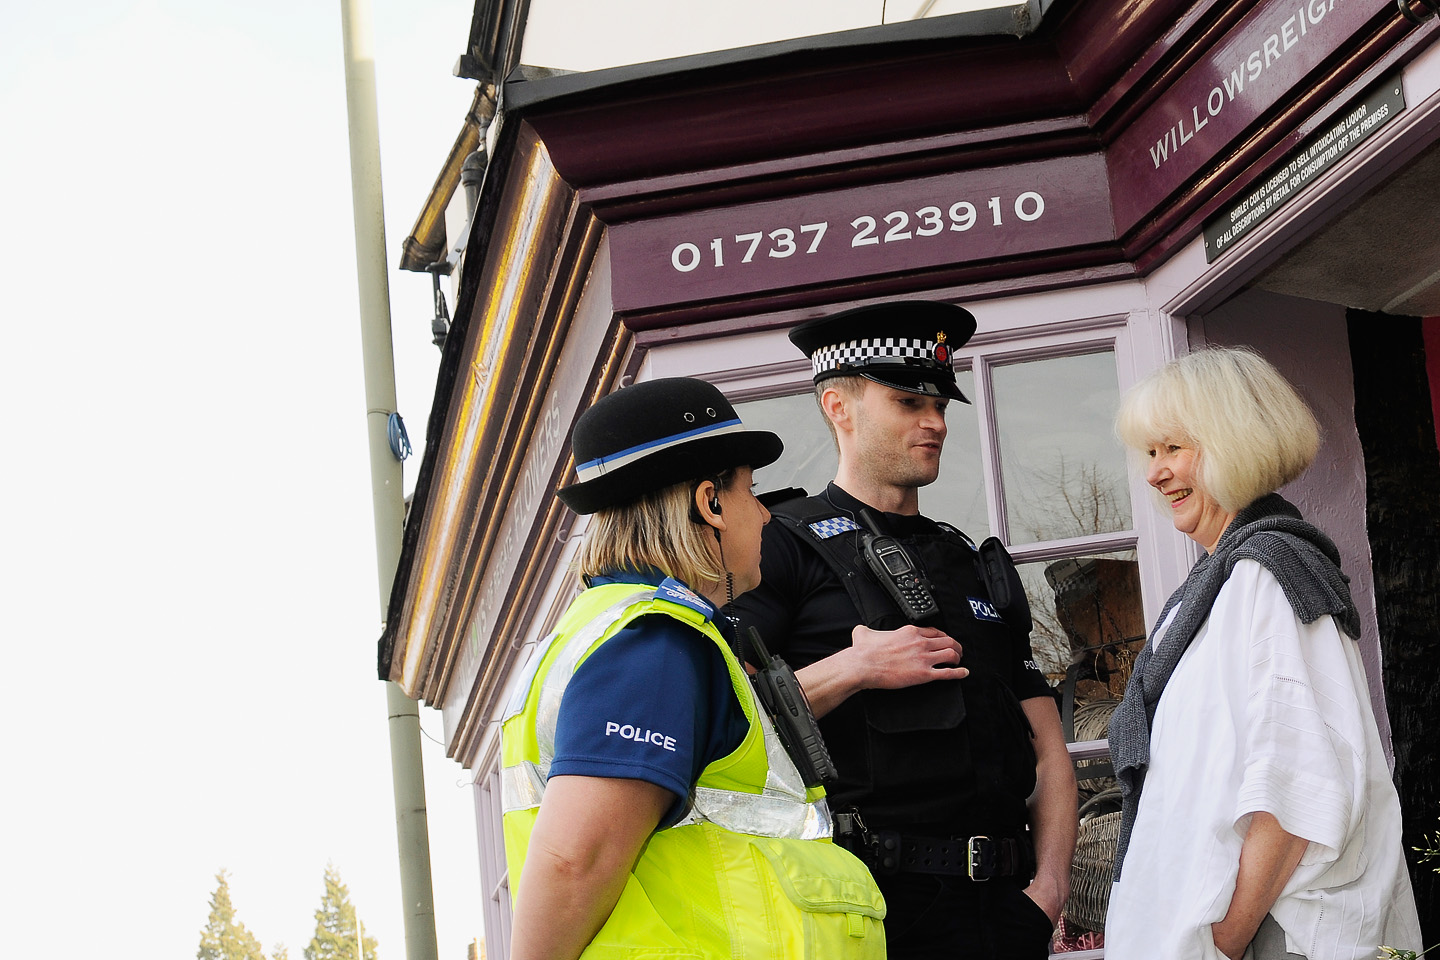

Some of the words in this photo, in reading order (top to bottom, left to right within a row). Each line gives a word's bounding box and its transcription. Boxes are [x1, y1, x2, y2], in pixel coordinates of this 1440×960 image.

[1216, 235, 1224, 249] OF
[1223, 229, 1233, 243] ALL
[1232, 202, 1266, 236] DESCRIPTIONS
[1265, 194, 1273, 210] BY
[1272, 182, 1291, 204] RETAIL
[1289, 173, 1301, 191] FOR
[1300, 143, 1338, 181] CONSUMPTION
[1338, 134, 1350, 151] OFF
[1349, 127, 1361, 143] THE
[1360, 103, 1389, 134] PREMISES
[1230, 199, 1250, 222] SHIRLEY
[1249, 191, 1261, 207] COX
[1260, 186, 1266, 199] IS
[1265, 167, 1290, 194] LICENSED
[1289, 160, 1297, 174] TO
[1296, 151, 1311, 168] SELL
[1310, 121, 1346, 157] INTOXICATING
[1345, 104, 1367, 130] LIQUOR
[671, 221, 828, 272] 01737
[850, 191, 1045, 248] 223910
[512, 389, 561, 546] FLOWERS
[605, 721, 677, 752] POLICE
